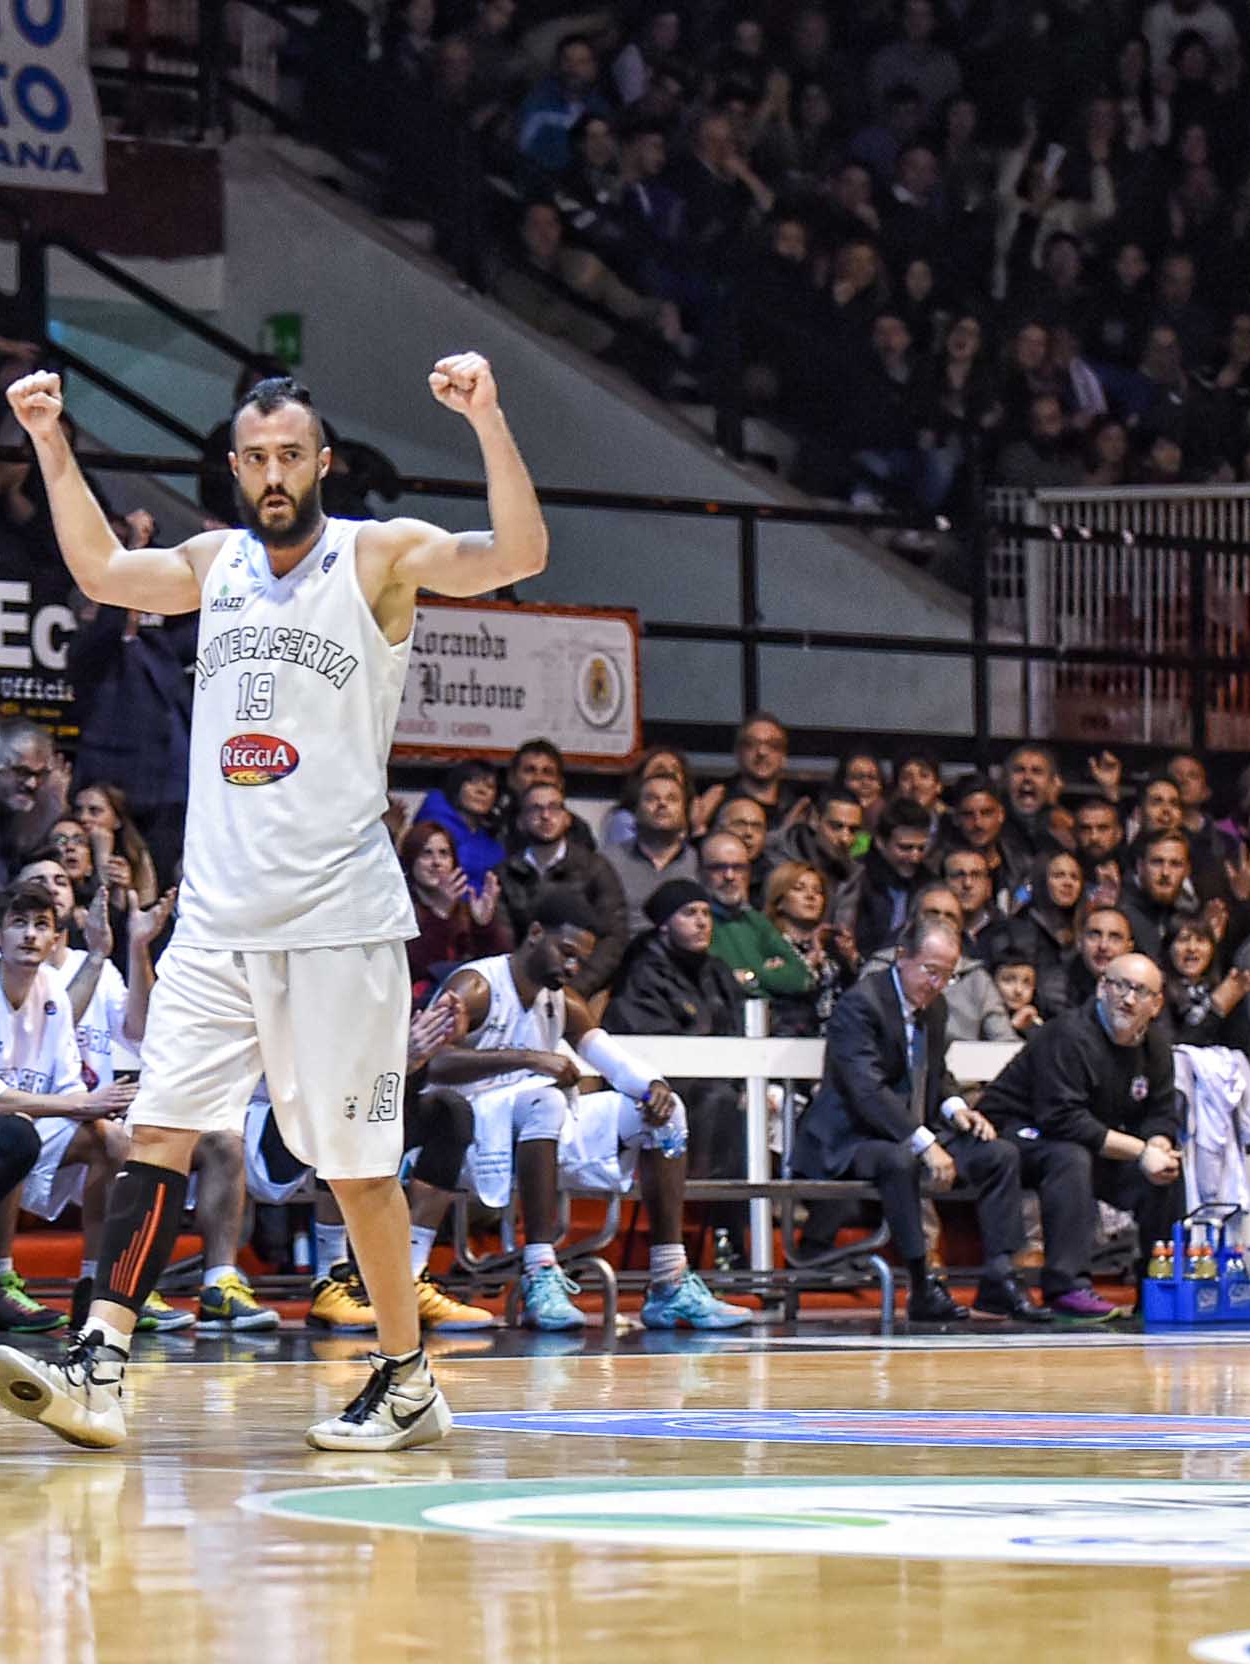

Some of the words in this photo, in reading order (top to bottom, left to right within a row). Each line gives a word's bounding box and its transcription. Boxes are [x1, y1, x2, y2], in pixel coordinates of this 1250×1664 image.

[236, 671, 276, 721] 19
[221, 744, 291, 768] REGGIA
[366, 1071, 401, 1123] 19
